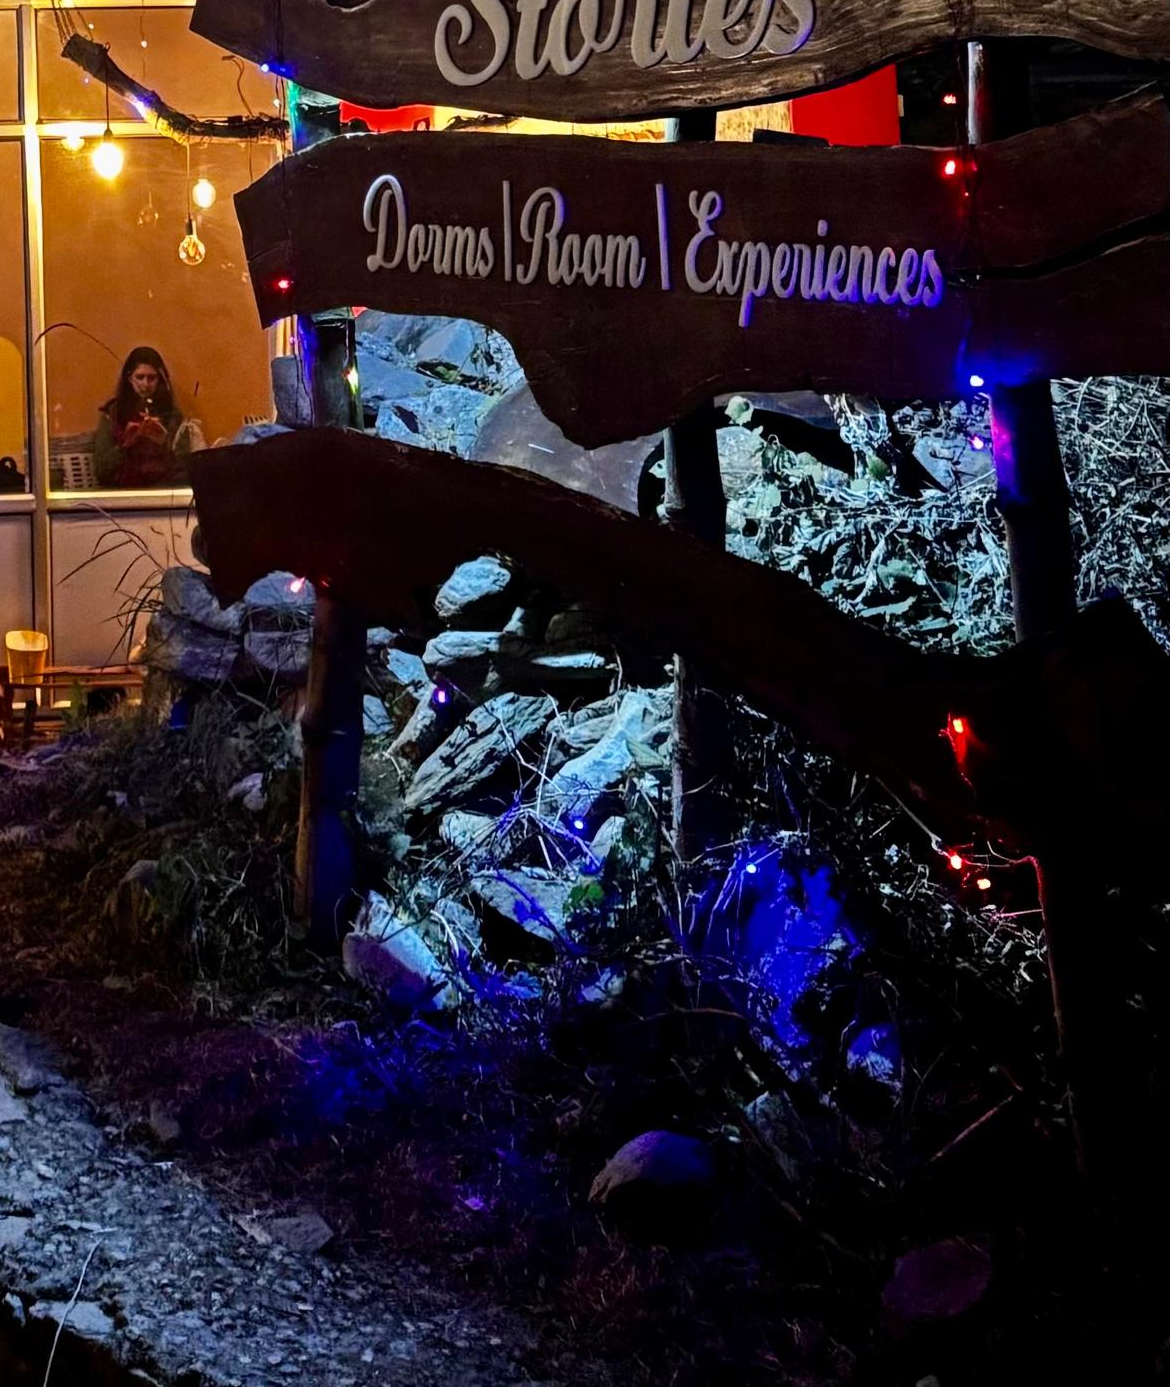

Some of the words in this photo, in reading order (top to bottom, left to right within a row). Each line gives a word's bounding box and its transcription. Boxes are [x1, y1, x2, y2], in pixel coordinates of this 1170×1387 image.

[363, 174, 495, 278] Dorms
[516, 186, 647, 289] Room
[684, 189, 945, 328] Experiences
